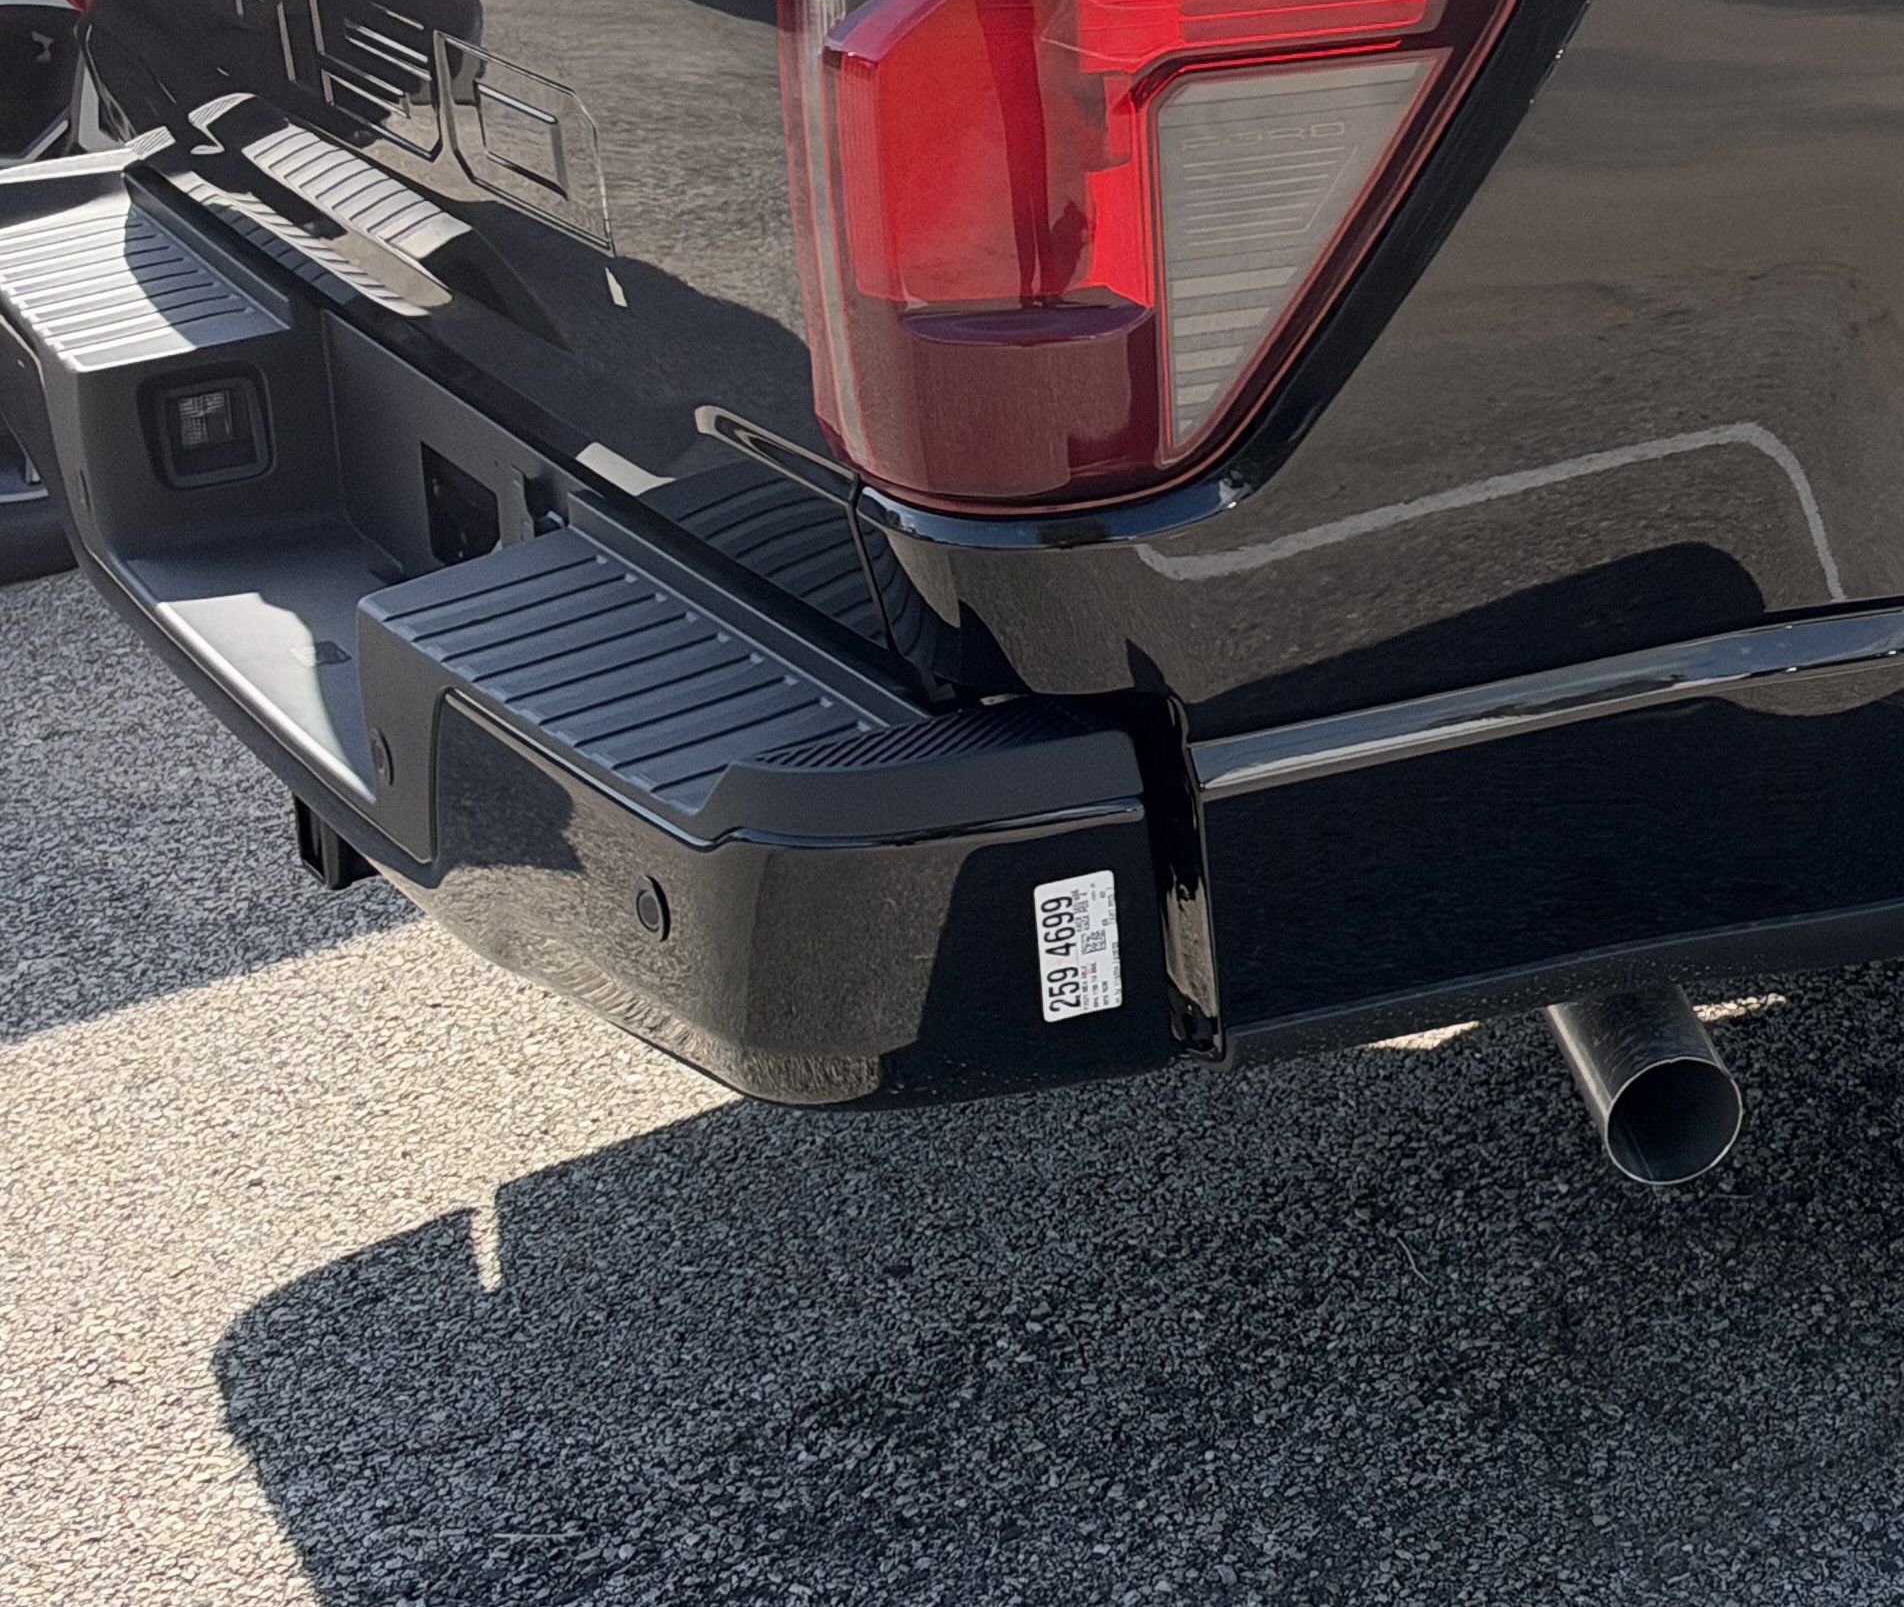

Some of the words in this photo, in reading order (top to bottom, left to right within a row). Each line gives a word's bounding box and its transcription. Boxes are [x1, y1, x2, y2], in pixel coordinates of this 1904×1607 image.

[1181, 122, 1345, 152] FORD
[1041, 895, 1077, 958] 4699
[1047, 966, 1081, 1012] 259
